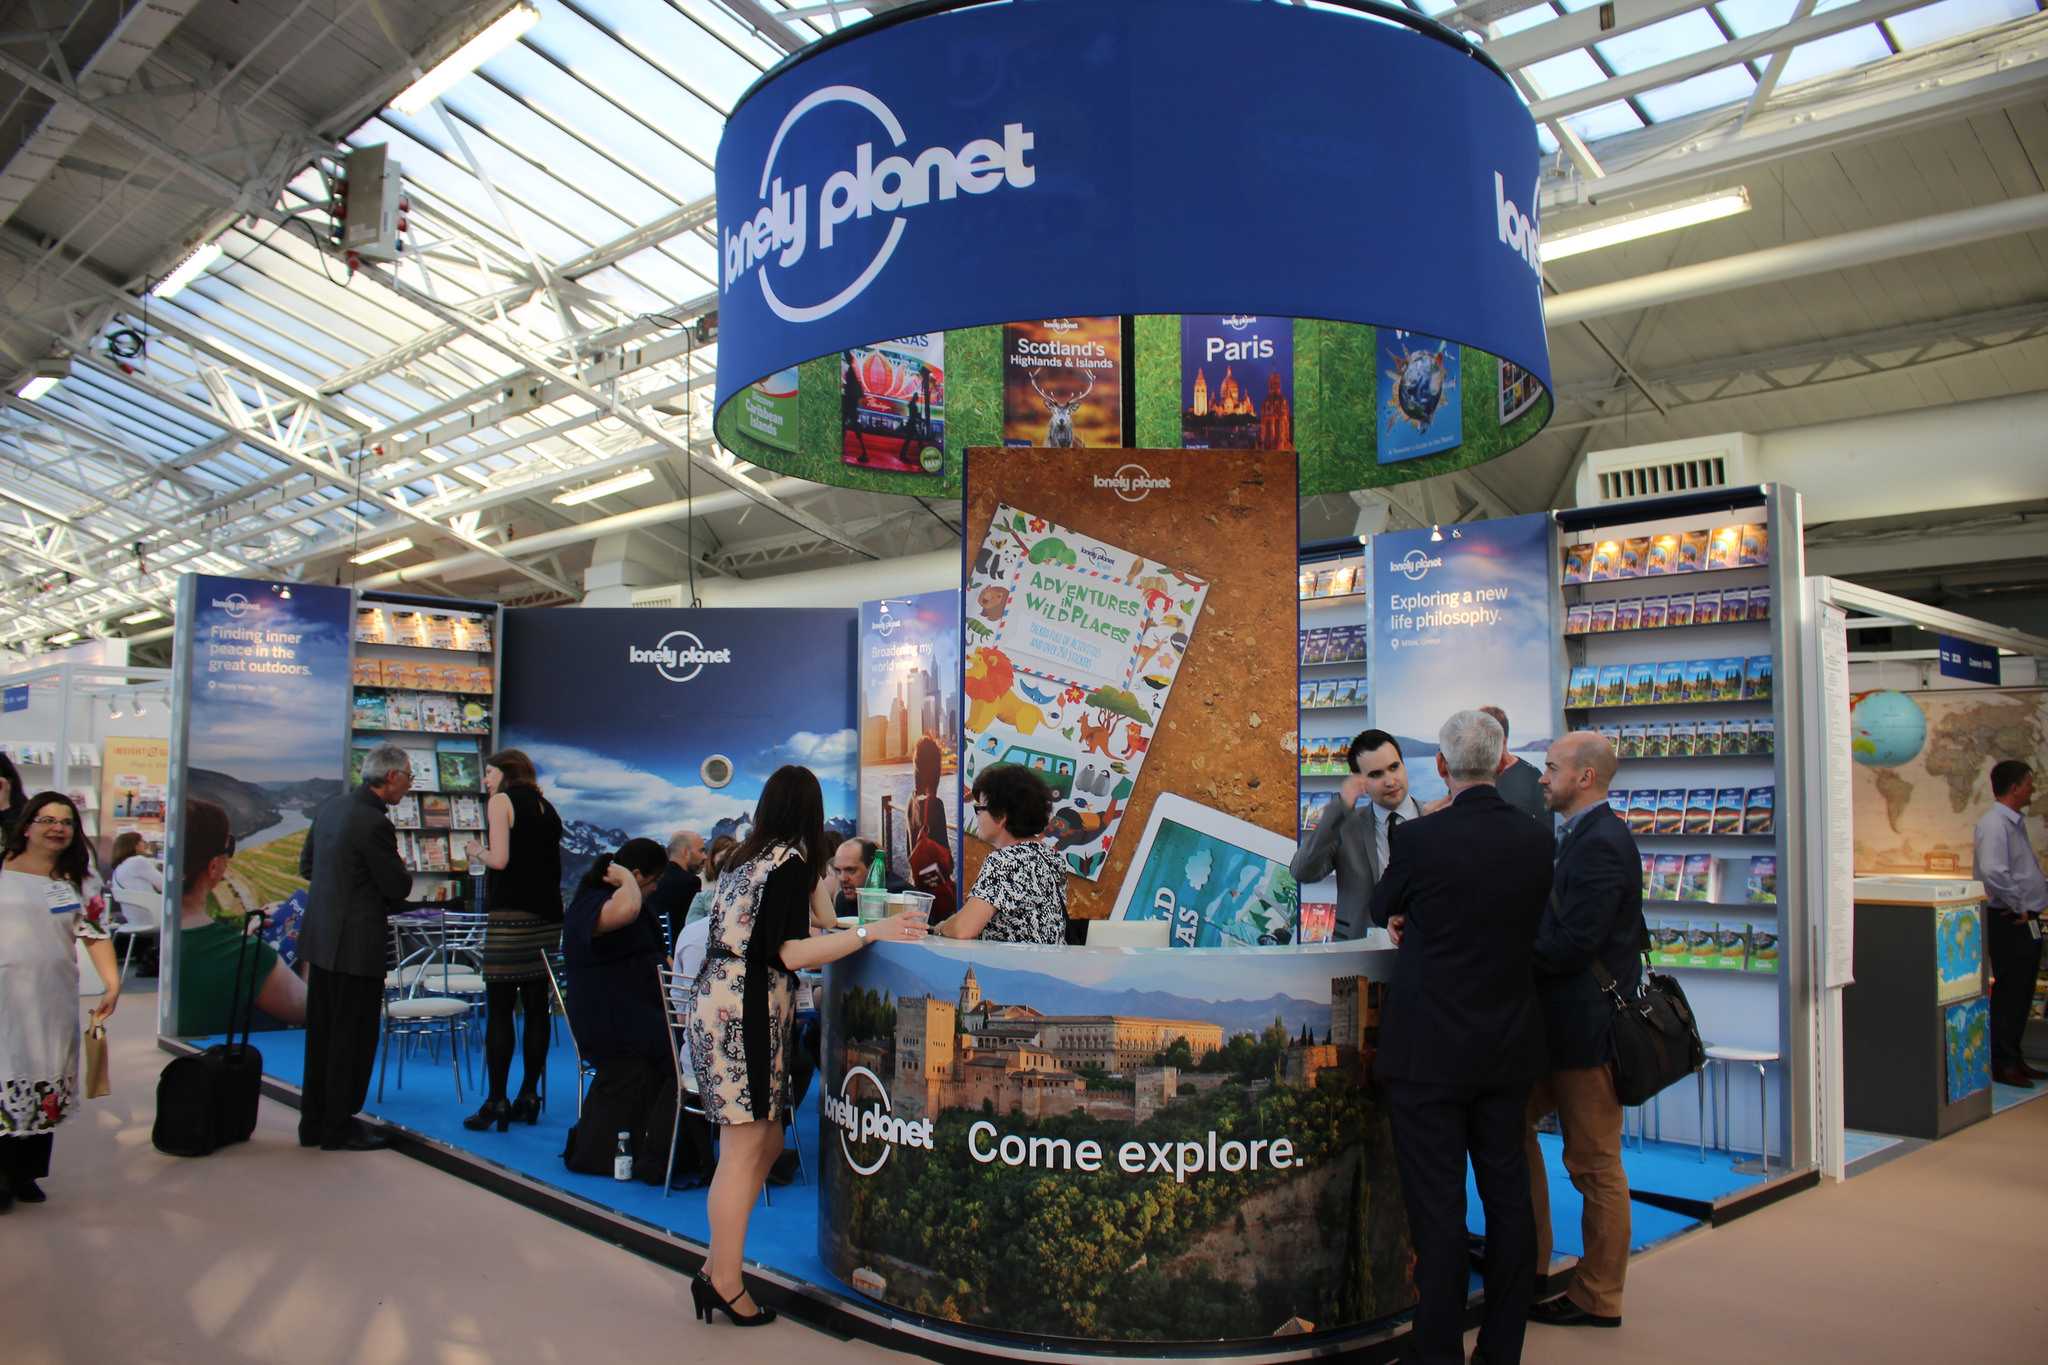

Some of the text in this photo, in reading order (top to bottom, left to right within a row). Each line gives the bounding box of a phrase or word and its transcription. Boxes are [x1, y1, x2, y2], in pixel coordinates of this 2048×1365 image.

[724, 122, 1036, 294] lonely planet
[1017, 338, 1105, 357] Scotland's
[1206, 334, 1274, 362] Paris
[1010, 354, 1113, 368] Highlands & Islands
[745, 398, 784, 426] Caribbean
[750, 414, 777, 436] Islands
[1093, 474, 1171, 491] lonely planet
[1081, 547, 1115, 565] lonely planet
[1390, 557, 1442, 573] lonely planet
[1030, 571, 1140, 616] ADVENTURES
[1391, 587, 1508, 612] Exploring a new
[1071, 605, 1131, 643] PLACES
[1391, 607, 1503, 631] life philosophy.
[210, 625, 302, 644] Finding inner
[209, 644, 295, 659] peace in the
[629, 645, 731, 668] lonely planet
[208, 658, 313, 676] great outdoors.
[824, 1083, 934, 1150] lonely planet
[967, 1120, 1304, 1184] Come explore.
